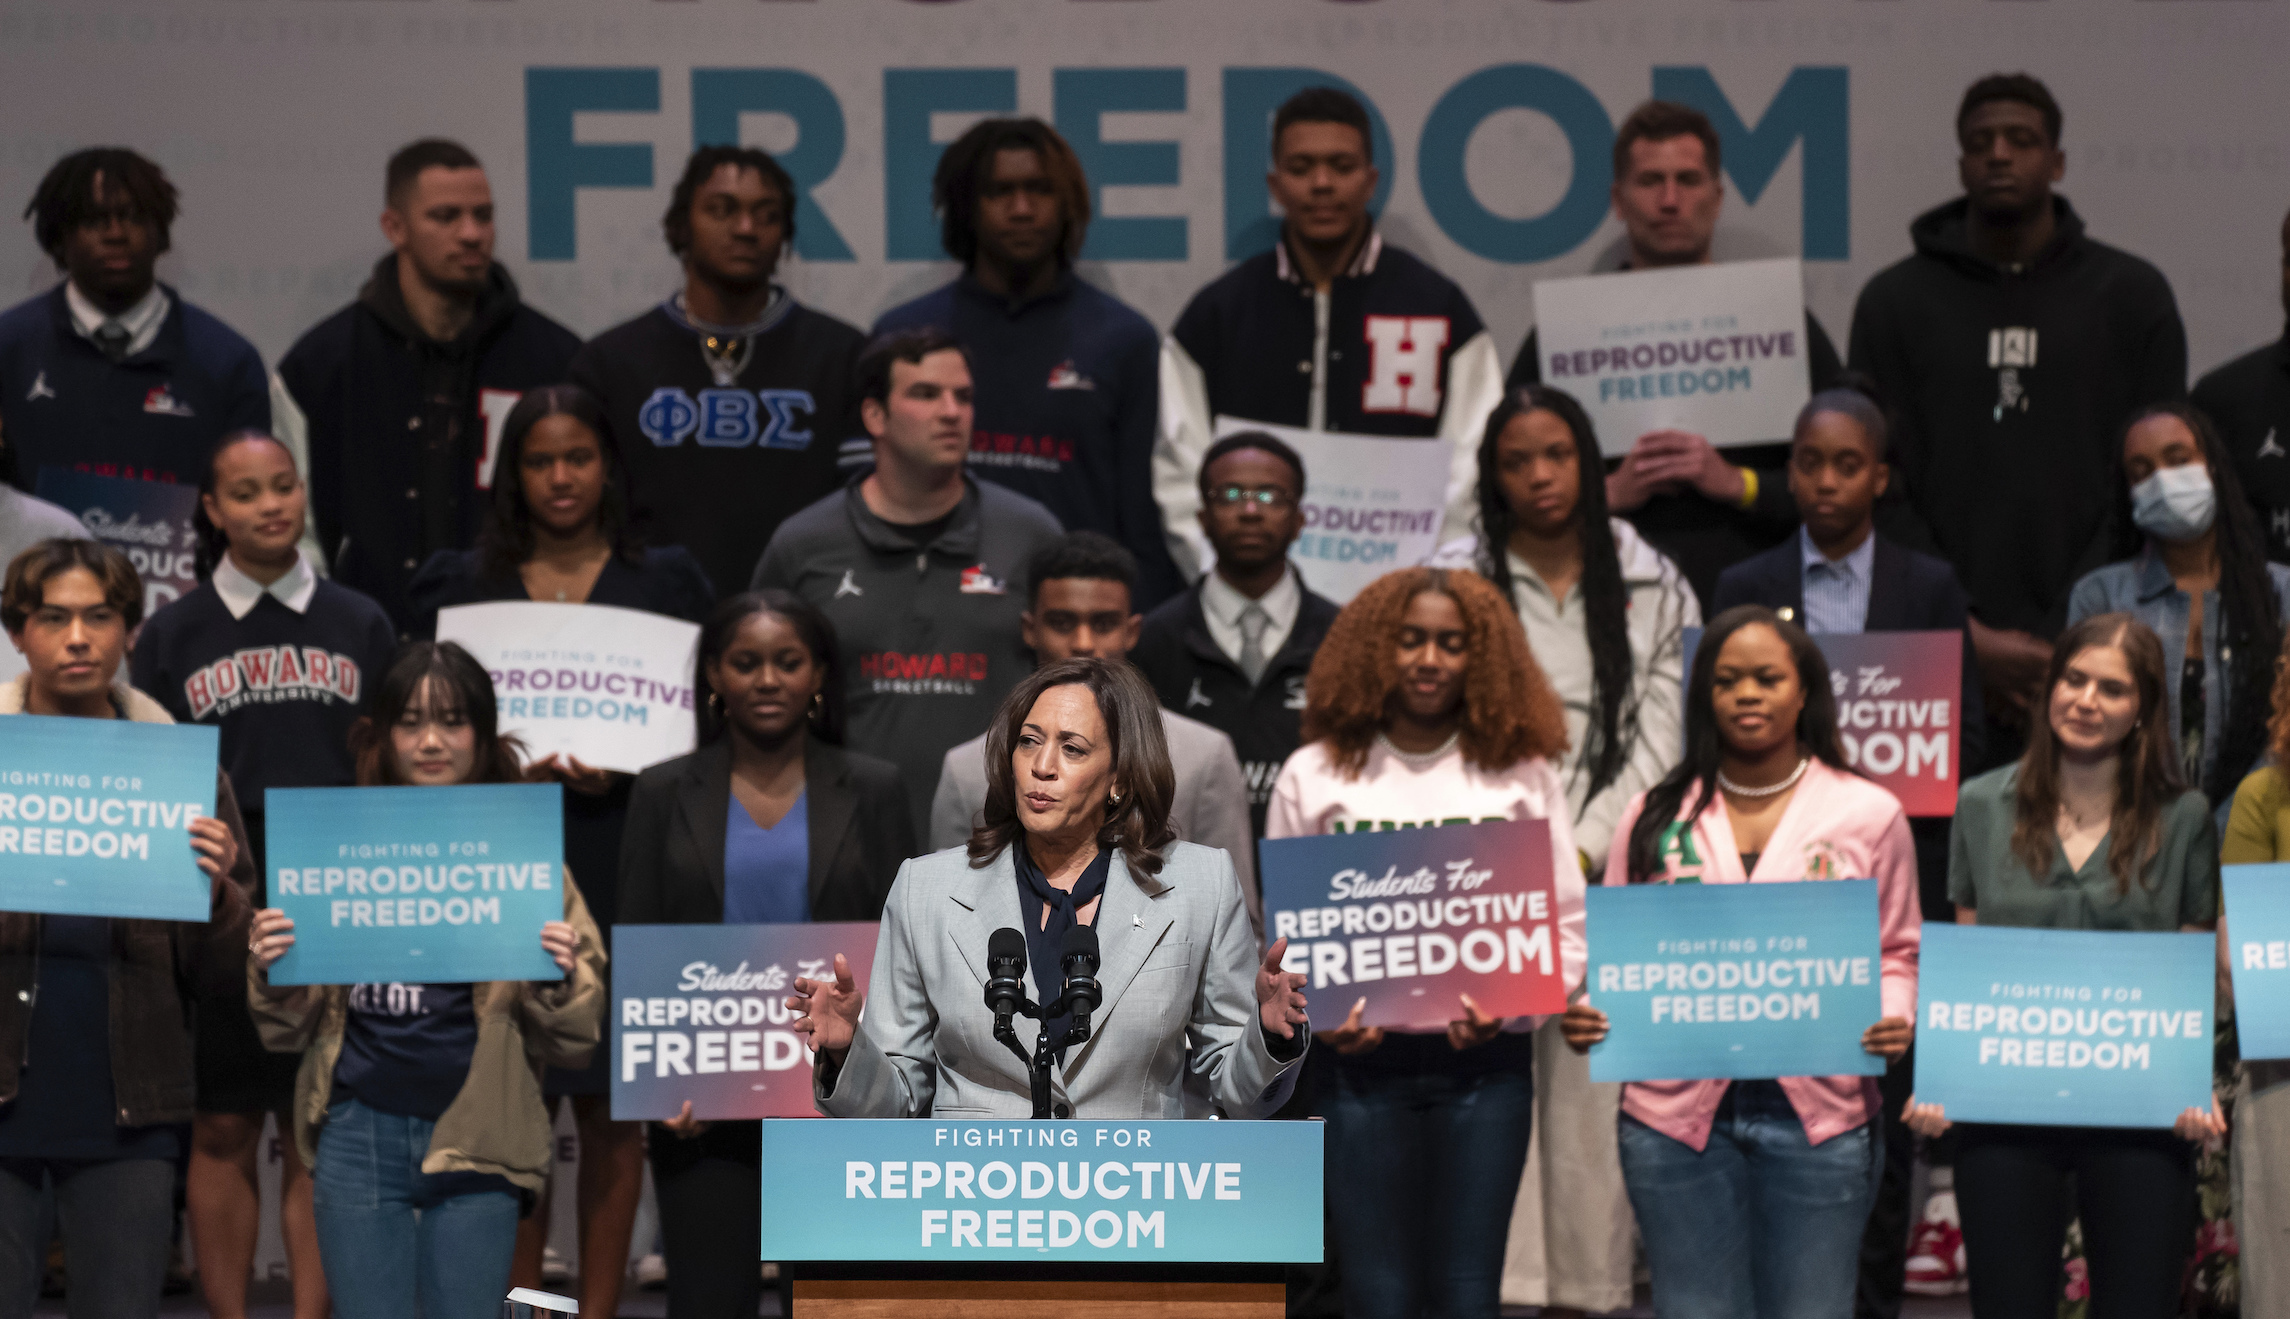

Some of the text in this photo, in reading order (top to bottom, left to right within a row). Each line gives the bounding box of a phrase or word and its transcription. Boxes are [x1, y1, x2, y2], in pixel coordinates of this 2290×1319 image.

[523, 63, 1851, 265] FREEDOM
[1361, 313, 1452, 418] H
[1550, 331, 1797, 377] REPRODUCTIVE
[1601, 366, 1751, 403] FREEDOM
[185, 644, 361, 720] HOWARD
[860, 651, 988, 681] HOWARD
[1857, 665, 1902, 697] For
[488, 669, 694, 711] PRODUCTIVE
[2, 770, 143, 792] IGHTING FOR
[0, 825, 149, 861] REEDOM
[339, 841, 490, 859] FIGHTING FOR
[278, 862, 551, 896] REPRODUCTIVE
[1328, 857, 1493, 901] Students For
[331, 897, 501, 928] FREEDOM
[1275, 890, 1549, 939] REPRODUCTIVE
[1657, 936, 1808, 955] FIGHTING FOR
[677, 960, 789, 992] Students
[1599, 957, 1871, 992] REPRODUCTIVE
[1990, 982, 2143, 1002] FIGHTING FOR
[1652, 992, 1820, 1024] FREEDOM
[1928, 1001, 2203, 1039] REPRODUCTIVE
[622, 1029, 814, 1083] FREED
[1979, 1037, 2150, 1070] FREEDOM
[935, 1127, 1153, 1148] FIGHTING FOR
[845, 1160, 1242, 1201] REPRODUCTIVE
[921, 1209, 1166, 1249] FREEDOM
